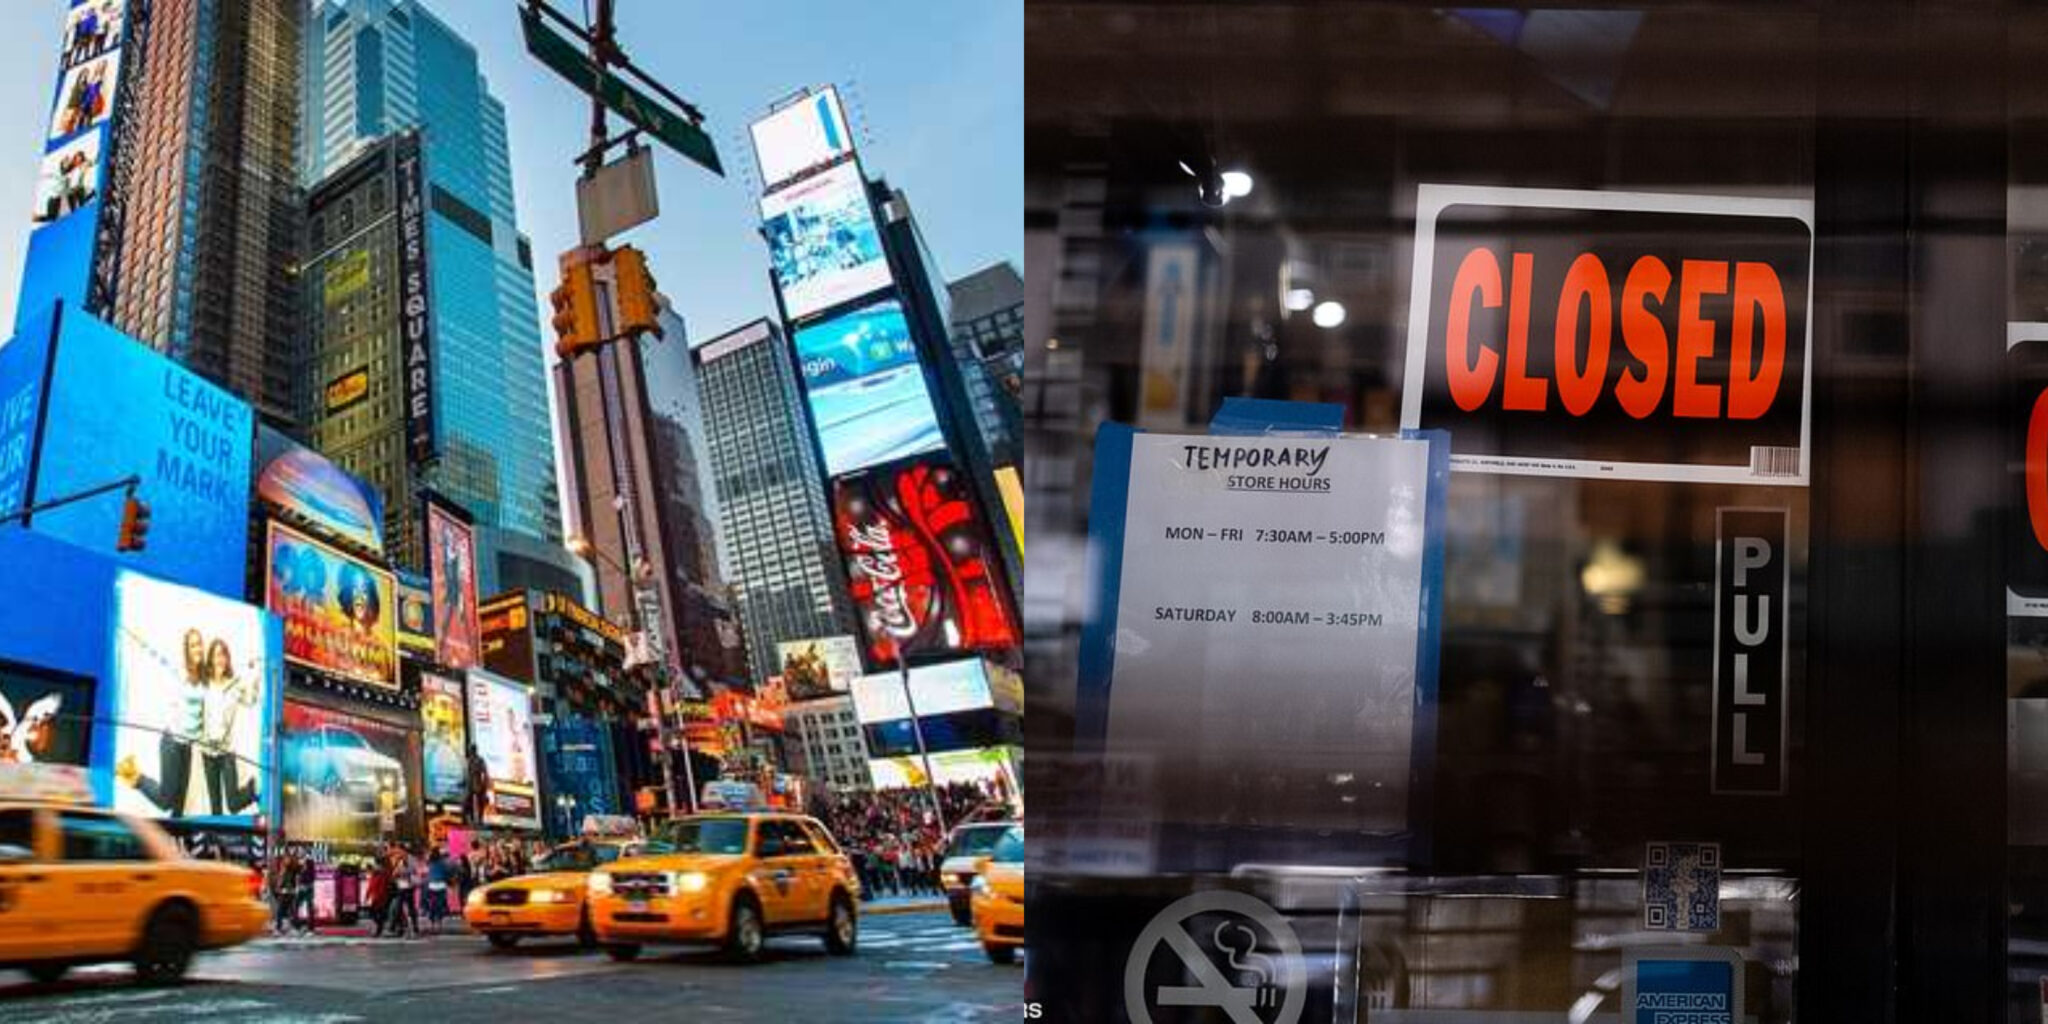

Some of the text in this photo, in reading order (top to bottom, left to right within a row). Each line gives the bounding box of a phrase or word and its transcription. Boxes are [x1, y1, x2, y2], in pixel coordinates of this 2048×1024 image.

[401, 157, 430, 419] TIMES SQUARE
[1446, 246, 1787, 420] CLOSED
[163, 367, 235, 432] LEAVE
[169, 409, 234, 472] YOUR
[1184, 445, 1331, 476] TEMPORARY
[1228, 475, 1331, 491] STORE HOURS
[1165, 527, 1204, 541] MON
[1220, 528, 1244, 542] FRI
[1256, 529, 1313, 543] 7:30AM
[1329, 531, 1386, 545] 5:00PM
[1154, 606, 1237, 623] SATURDAY
[1252, 610, 1310, 625] 8:00AM
[1326, 612, 1383, 627] 3:45PM
[1732, 536, 1772, 765] PULL
[1636, 992, 1727, 1011] AMERICAN
[1654, 1012, 1732, 1024] EXPRESS
